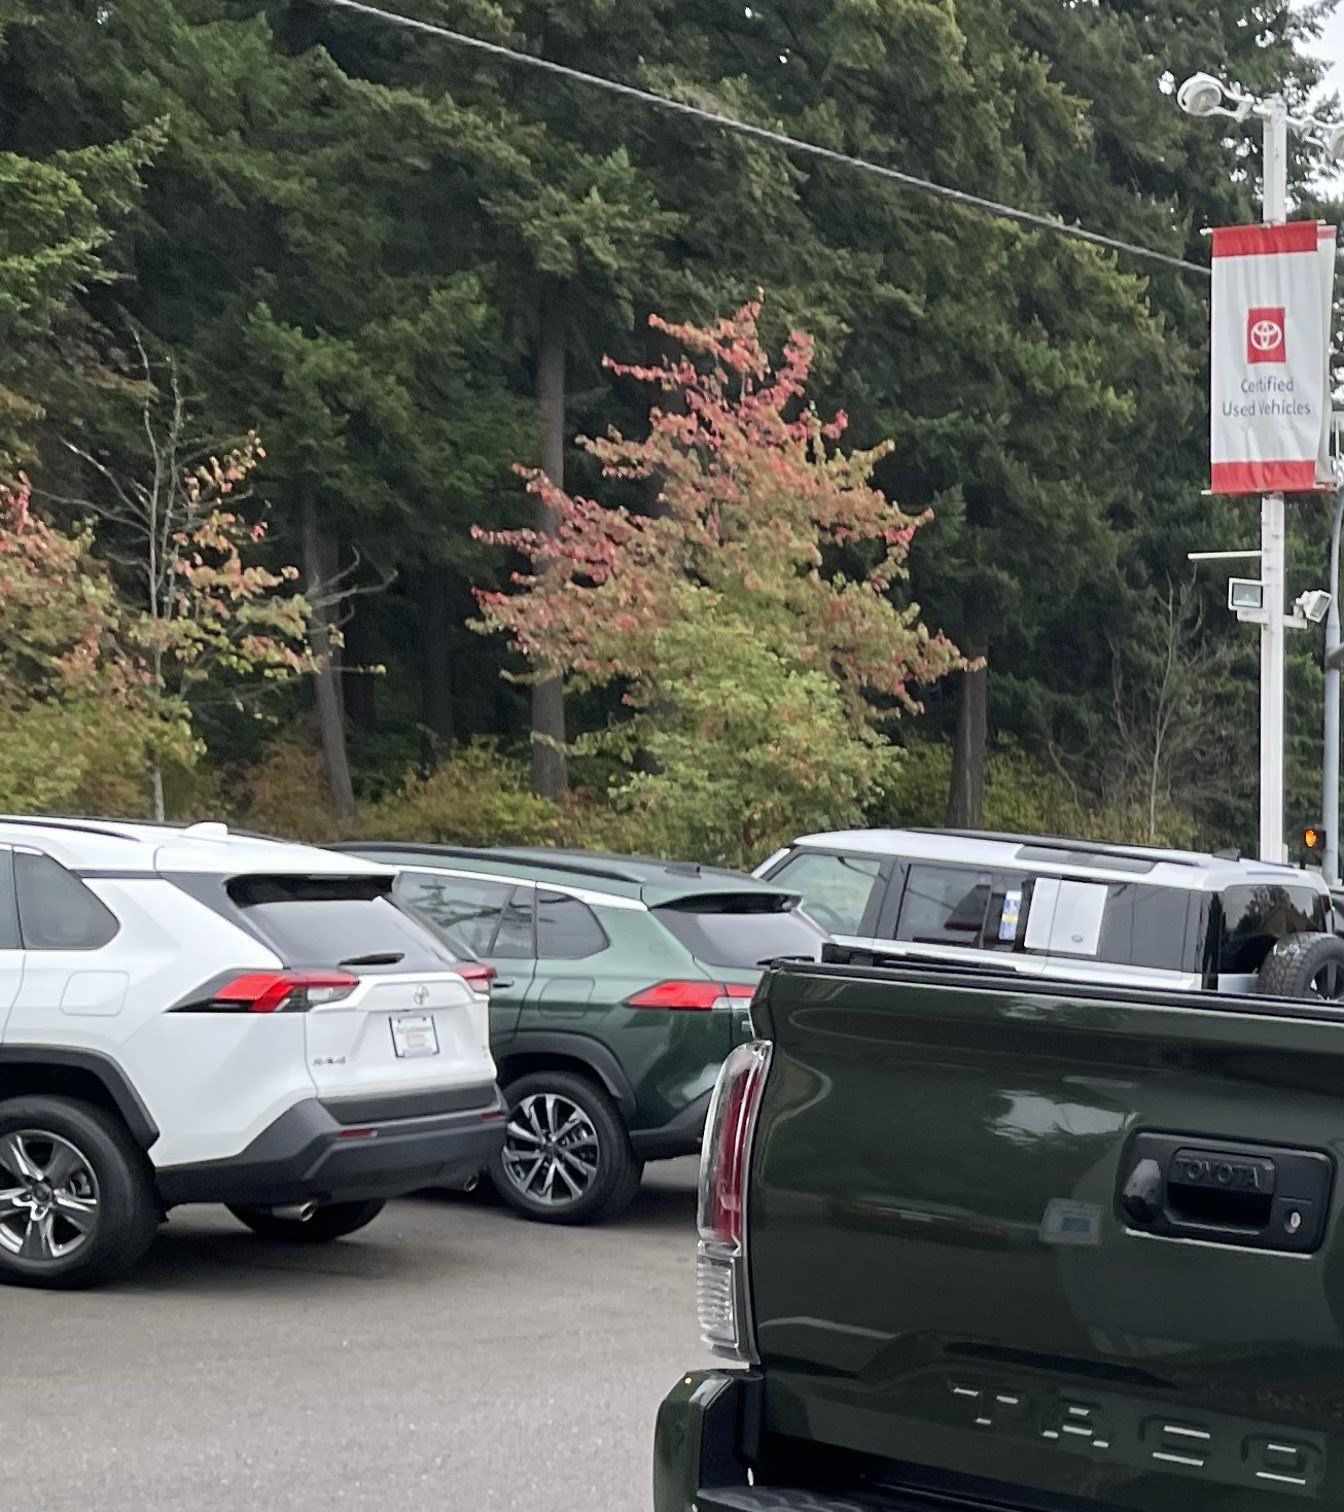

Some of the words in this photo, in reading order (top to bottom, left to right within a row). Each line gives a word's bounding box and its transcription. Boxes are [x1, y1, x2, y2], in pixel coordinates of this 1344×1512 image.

[1241, 376, 1295, 394] Certified
[1222, 402, 1255, 417] Used
[1257, 401, 1311, 416] Vehicles
